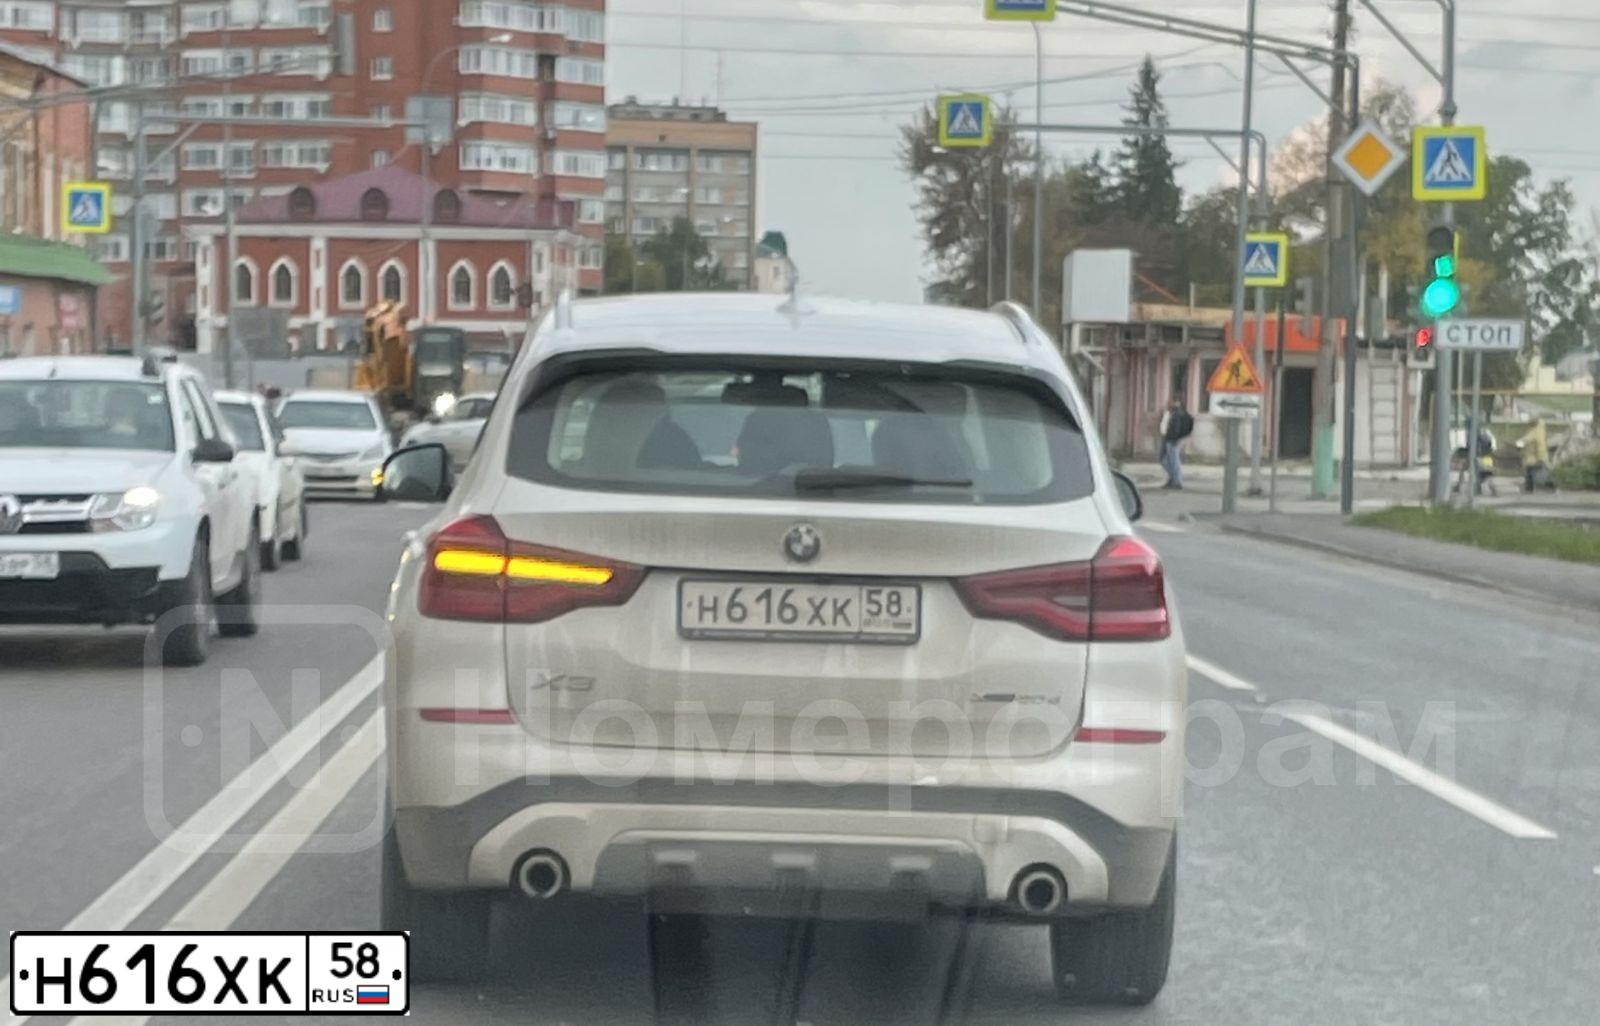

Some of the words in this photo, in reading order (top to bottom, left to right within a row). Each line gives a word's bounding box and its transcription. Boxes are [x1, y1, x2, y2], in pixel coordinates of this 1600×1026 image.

[1446, 324, 1512, 345] СТОП
[697, 587, 852, 627] Н616ХК
[865, 589, 902, 618] 58
